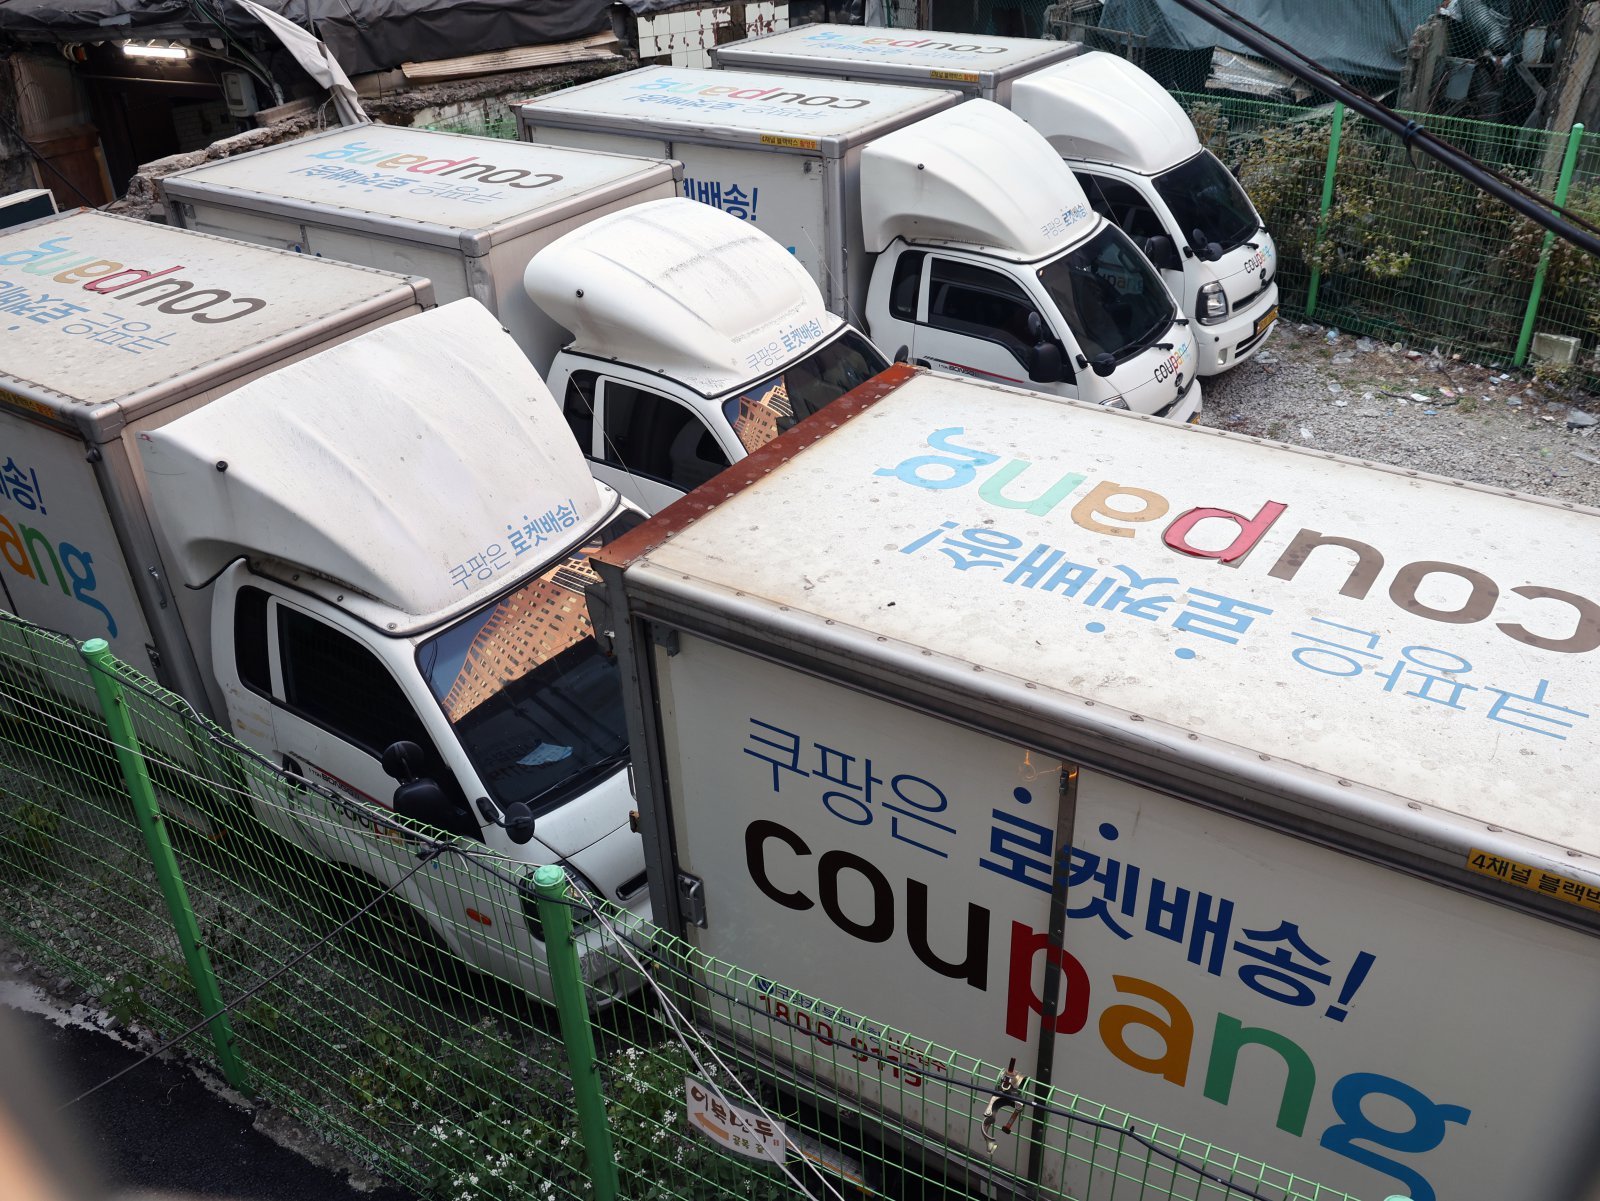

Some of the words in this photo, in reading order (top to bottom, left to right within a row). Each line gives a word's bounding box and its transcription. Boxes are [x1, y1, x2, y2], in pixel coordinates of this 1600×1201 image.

[630, 77, 871, 110] coupang
[288, 164, 421, 192] 로켓배송!
[306, 141, 564, 189] coupang
[409, 181, 504, 205] 쿠팡은
[0, 236, 267, 323] coupang
[62, 312, 177, 354] 쿠팡은
[745, 341, 785, 372] 쿠팡은
[779, 317, 824, 353] 로켓배송!
[448, 543, 511, 590] 쿠팡은
[507, 498, 580, 557] 로켓배송!
[873, 426, 1600, 654] coupang
[900, 521, 1274, 660] 로켓배송!
[1290, 616, 1590, 742] 쿠팡은
[743, 717, 957, 859] 쿠팡은
[979, 786, 1377, 1023] 로켓배송!
[1471, 854, 1532, 885] 4채널
[744, 819, 1472, 1201] coupang
